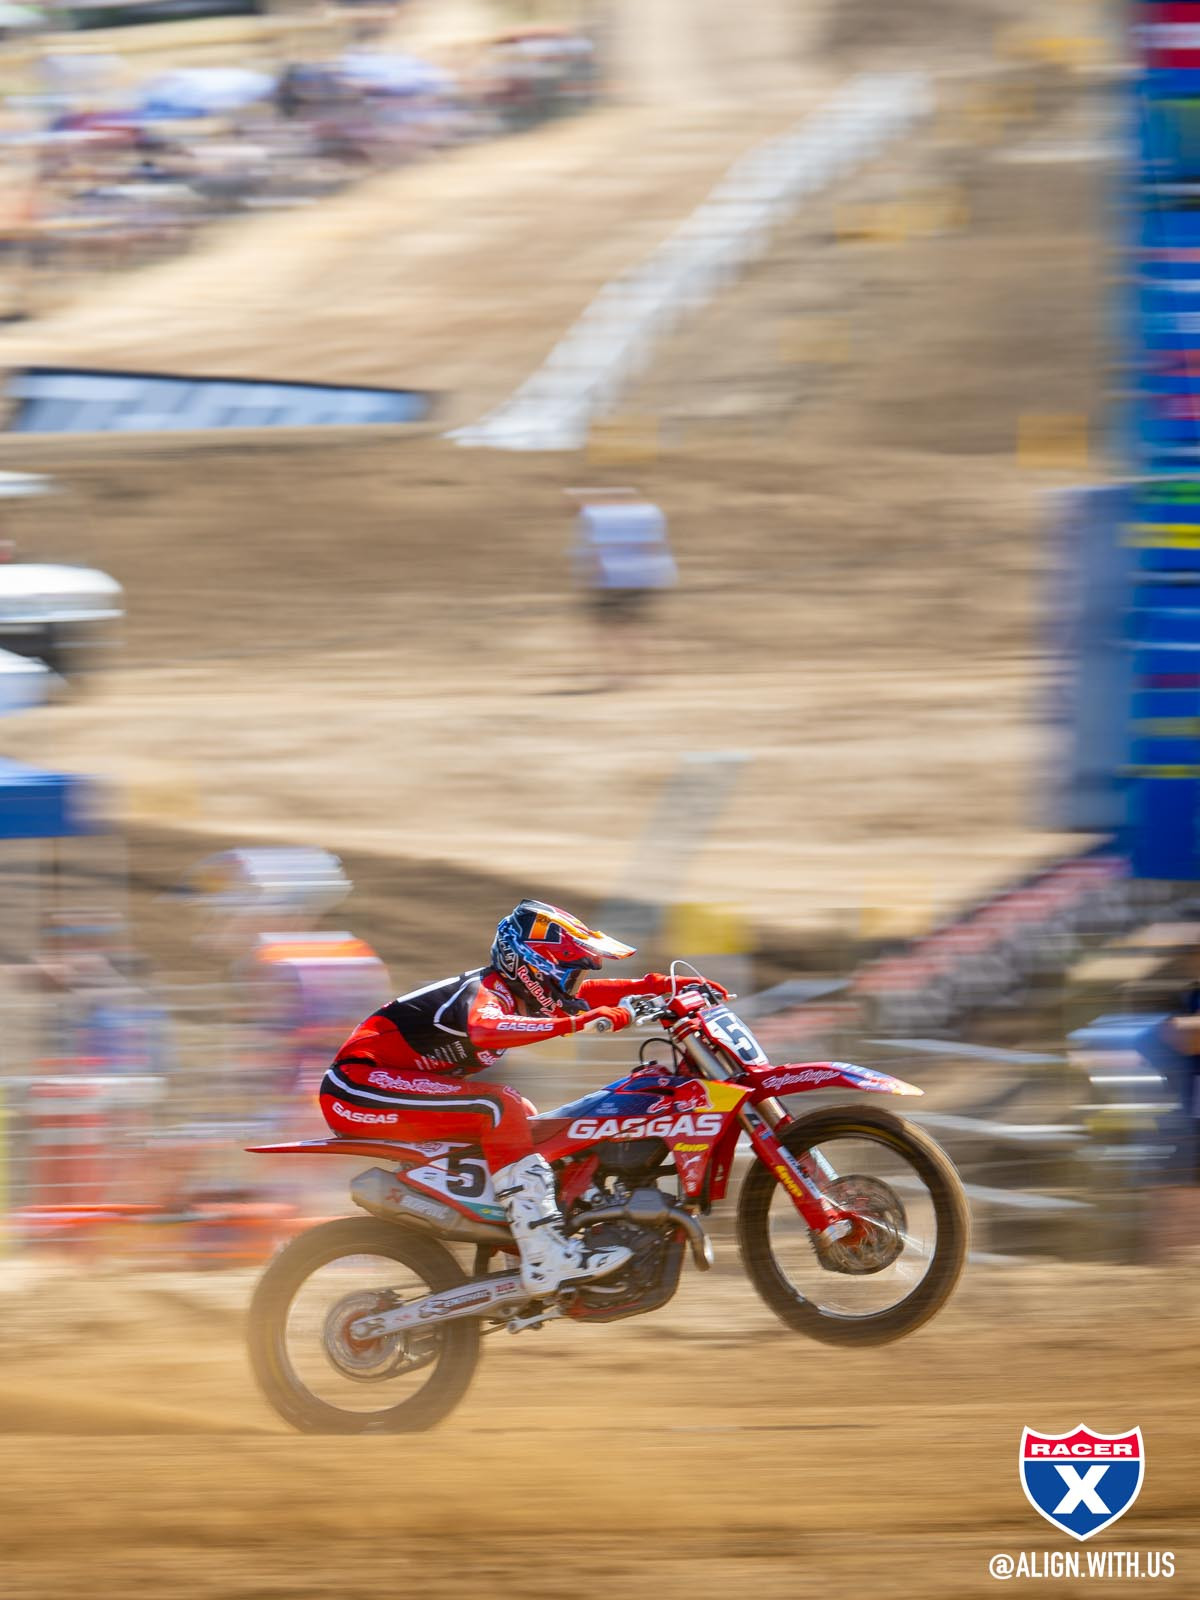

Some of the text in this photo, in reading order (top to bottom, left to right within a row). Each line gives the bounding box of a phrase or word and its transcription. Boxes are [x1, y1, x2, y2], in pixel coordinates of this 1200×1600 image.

[496, 1022, 554, 1032] GASGAS
[714, 1015, 758, 1061] 5
[332, 1101, 399, 1124] GASGAS
[567, 1113, 724, 1140] GASGAS
[446, 1146, 487, 1198] 5
